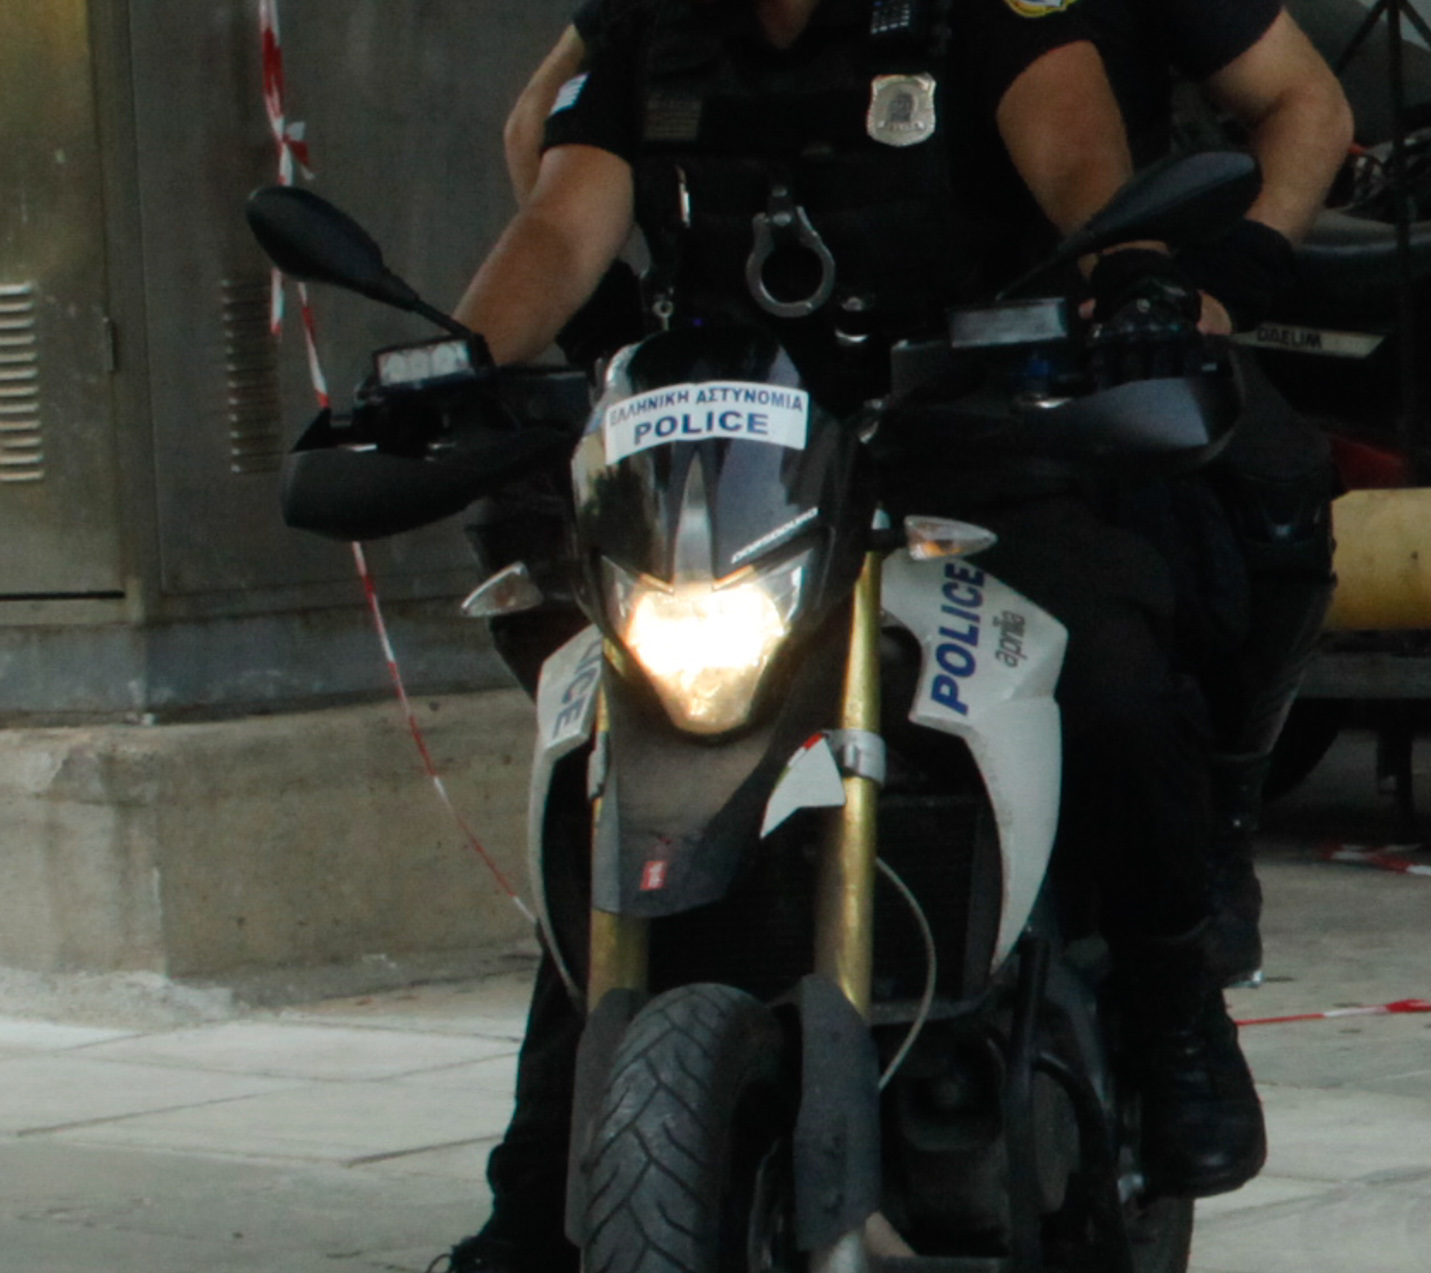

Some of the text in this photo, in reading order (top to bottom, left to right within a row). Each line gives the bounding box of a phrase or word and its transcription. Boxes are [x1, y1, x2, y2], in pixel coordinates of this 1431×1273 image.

[609, 387, 804, 427] ΕΛΛΗΝΙΚΗ ΑΣΤΥΝΟΜΙΑ
[633, 409, 769, 446] POLICE
[930, 562, 986, 717] POLICE
